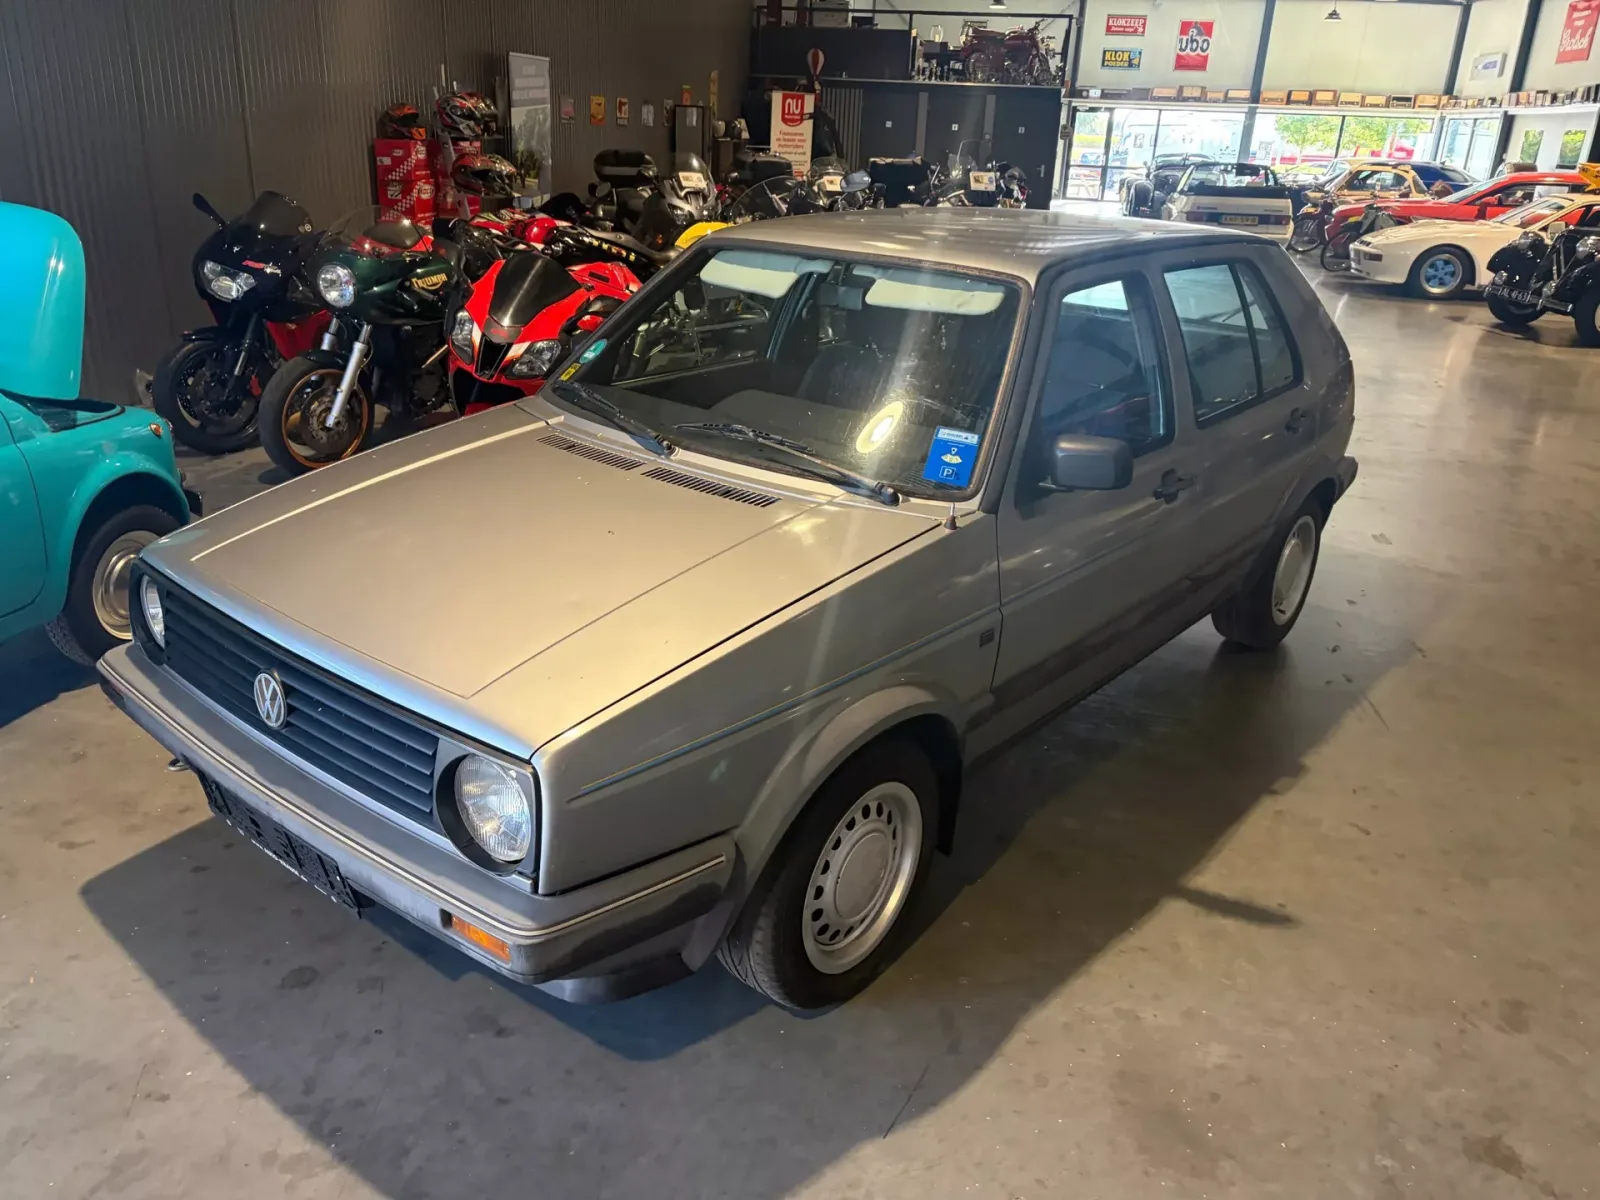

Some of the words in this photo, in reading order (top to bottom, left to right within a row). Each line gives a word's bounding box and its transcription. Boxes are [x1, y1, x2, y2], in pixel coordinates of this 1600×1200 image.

[1108, 18, 1145, 27] KLOKZEEP
[1178, 34, 1210, 53] ubo
[1105, 51, 1130, 61] KLOK
[412, 273, 448, 289] TRIUMPH
